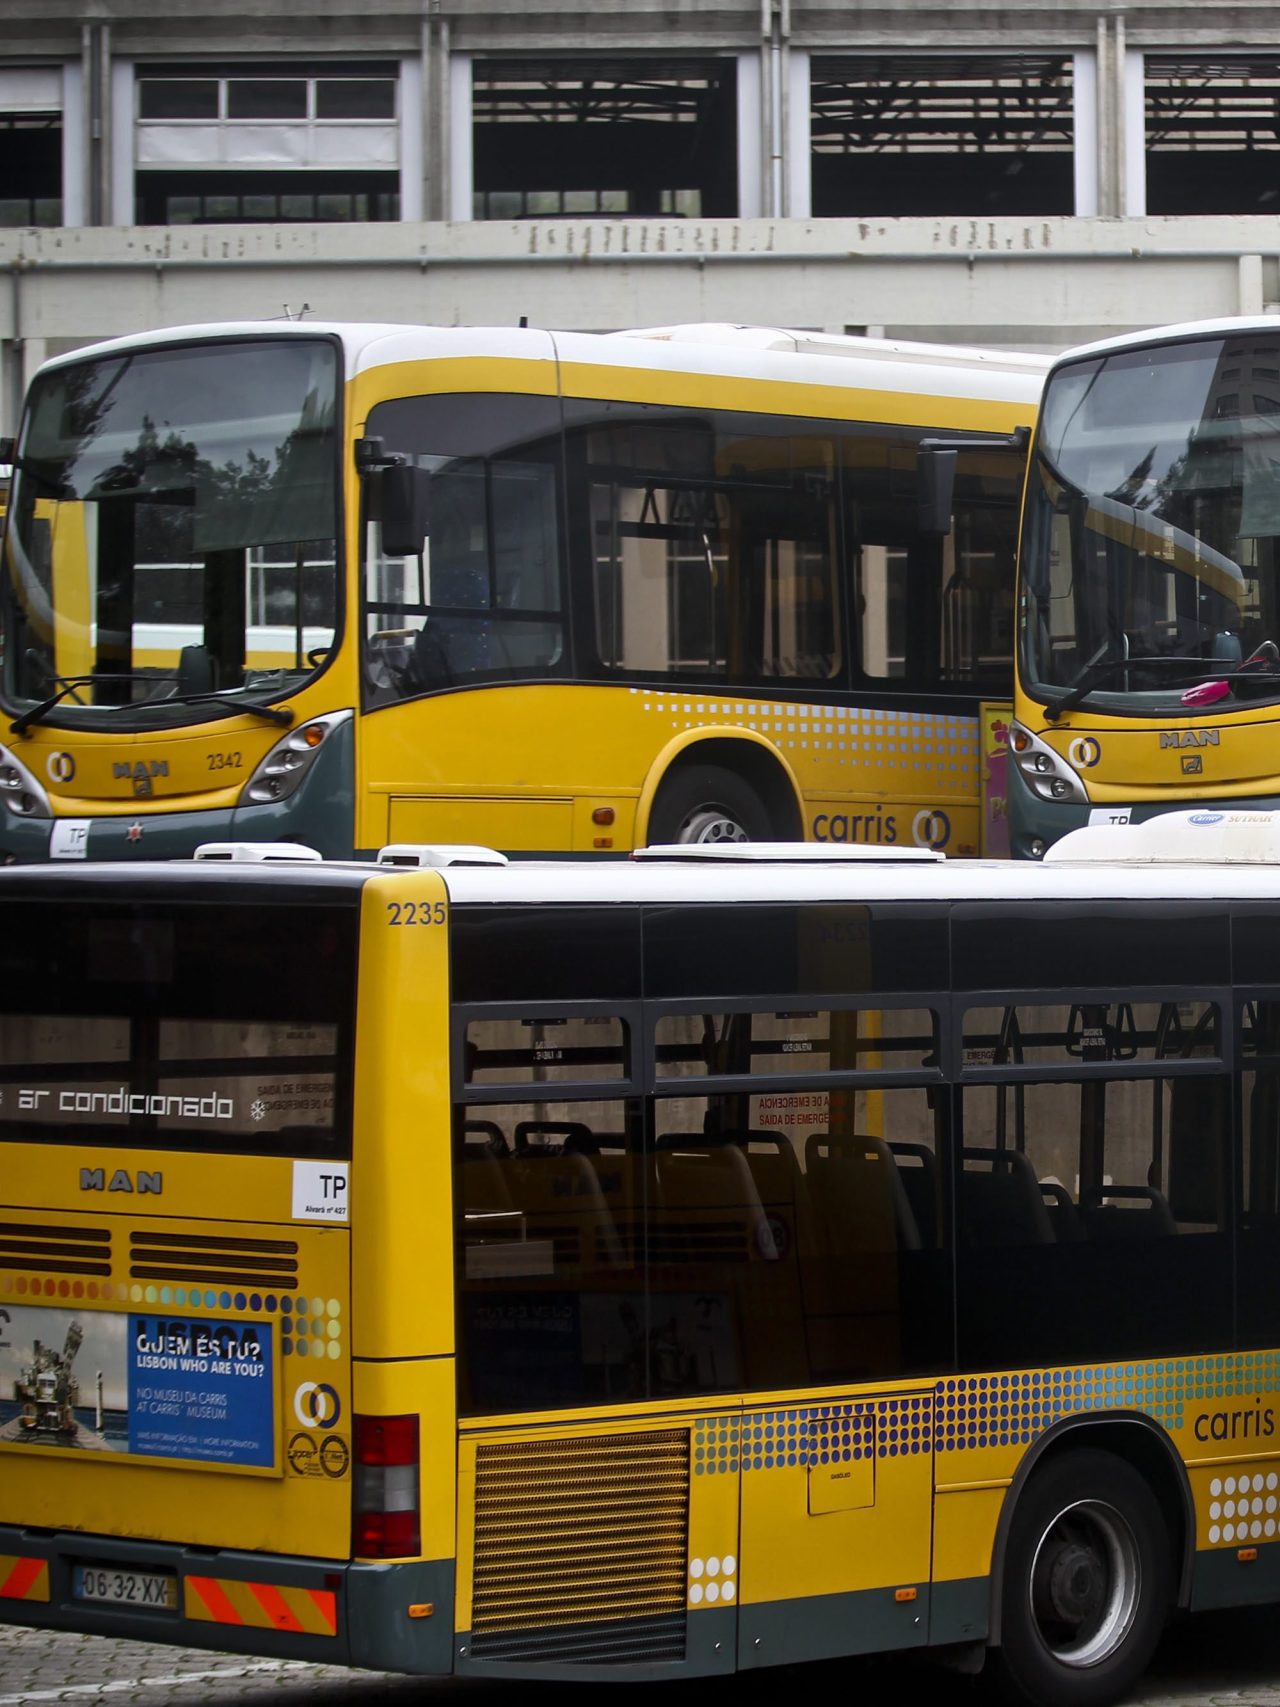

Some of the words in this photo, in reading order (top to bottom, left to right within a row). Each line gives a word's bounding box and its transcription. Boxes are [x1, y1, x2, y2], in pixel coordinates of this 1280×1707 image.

[1159, 730, 1221, 749] MAN
[112, 760, 170, 779] MAN
[207, 751, 243, 771] 2342
[813, 805, 897, 843] carris
[70, 828, 86, 844] TP
[388, 902, 446, 926] 2235
[18, 1089, 50, 1110] ar
[59, 1087, 234, 1119] condicionado
[79, 1167, 163, 1195] MAN
[319, 1175, 346, 1199] TP
[136, 1334, 190, 1356] QUEM
[197, 1335, 220, 1358] ÉS
[227, 1341, 260, 1361] TU?
[137, 1355, 177, 1370] LISBON
[179, 1358, 208, 1373] WHO
[210, 1361, 232, 1375] ARE
[233, 1362, 264, 1377] YOU?
[136, 1387, 152, 1400] NO
[154, 1389, 183, 1402] MUSEU
[199, 1392, 228, 1407] CARRIS
[136, 1401, 147, 1412] AT
[186, 1406, 227, 1420] MUSEUM
[1194, 1397, 1275, 1442] carris
